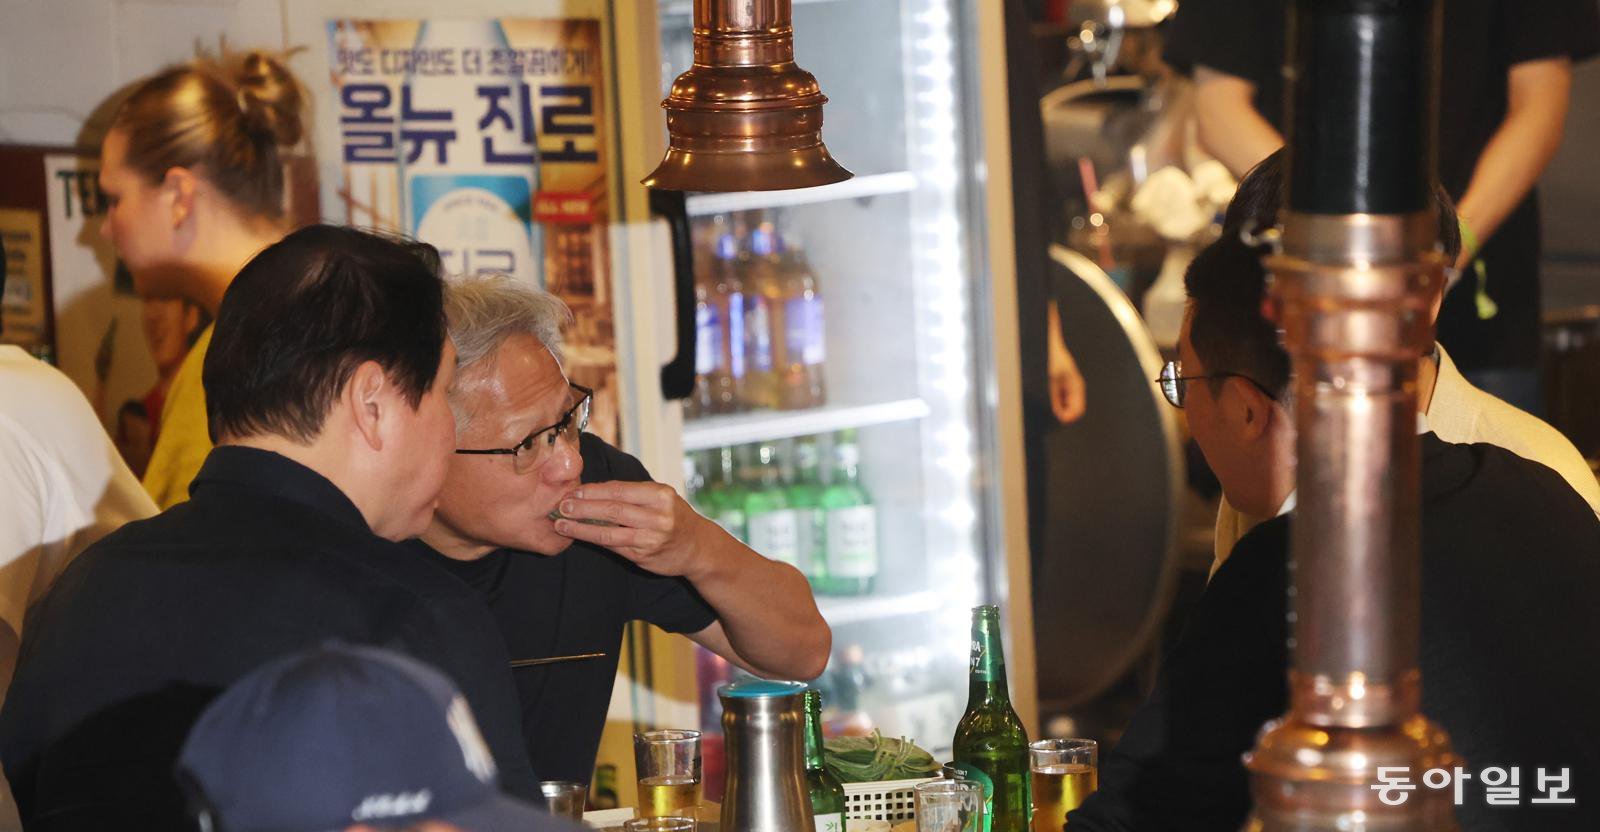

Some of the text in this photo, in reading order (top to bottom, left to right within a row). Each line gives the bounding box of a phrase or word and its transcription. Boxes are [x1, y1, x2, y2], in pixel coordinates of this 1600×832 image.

[338, 49, 374, 76] 맛도
[380, 48, 455, 76] 디자인도
[462, 48, 481, 75] 더
[341, 83, 598, 164] 올뉴 진로
